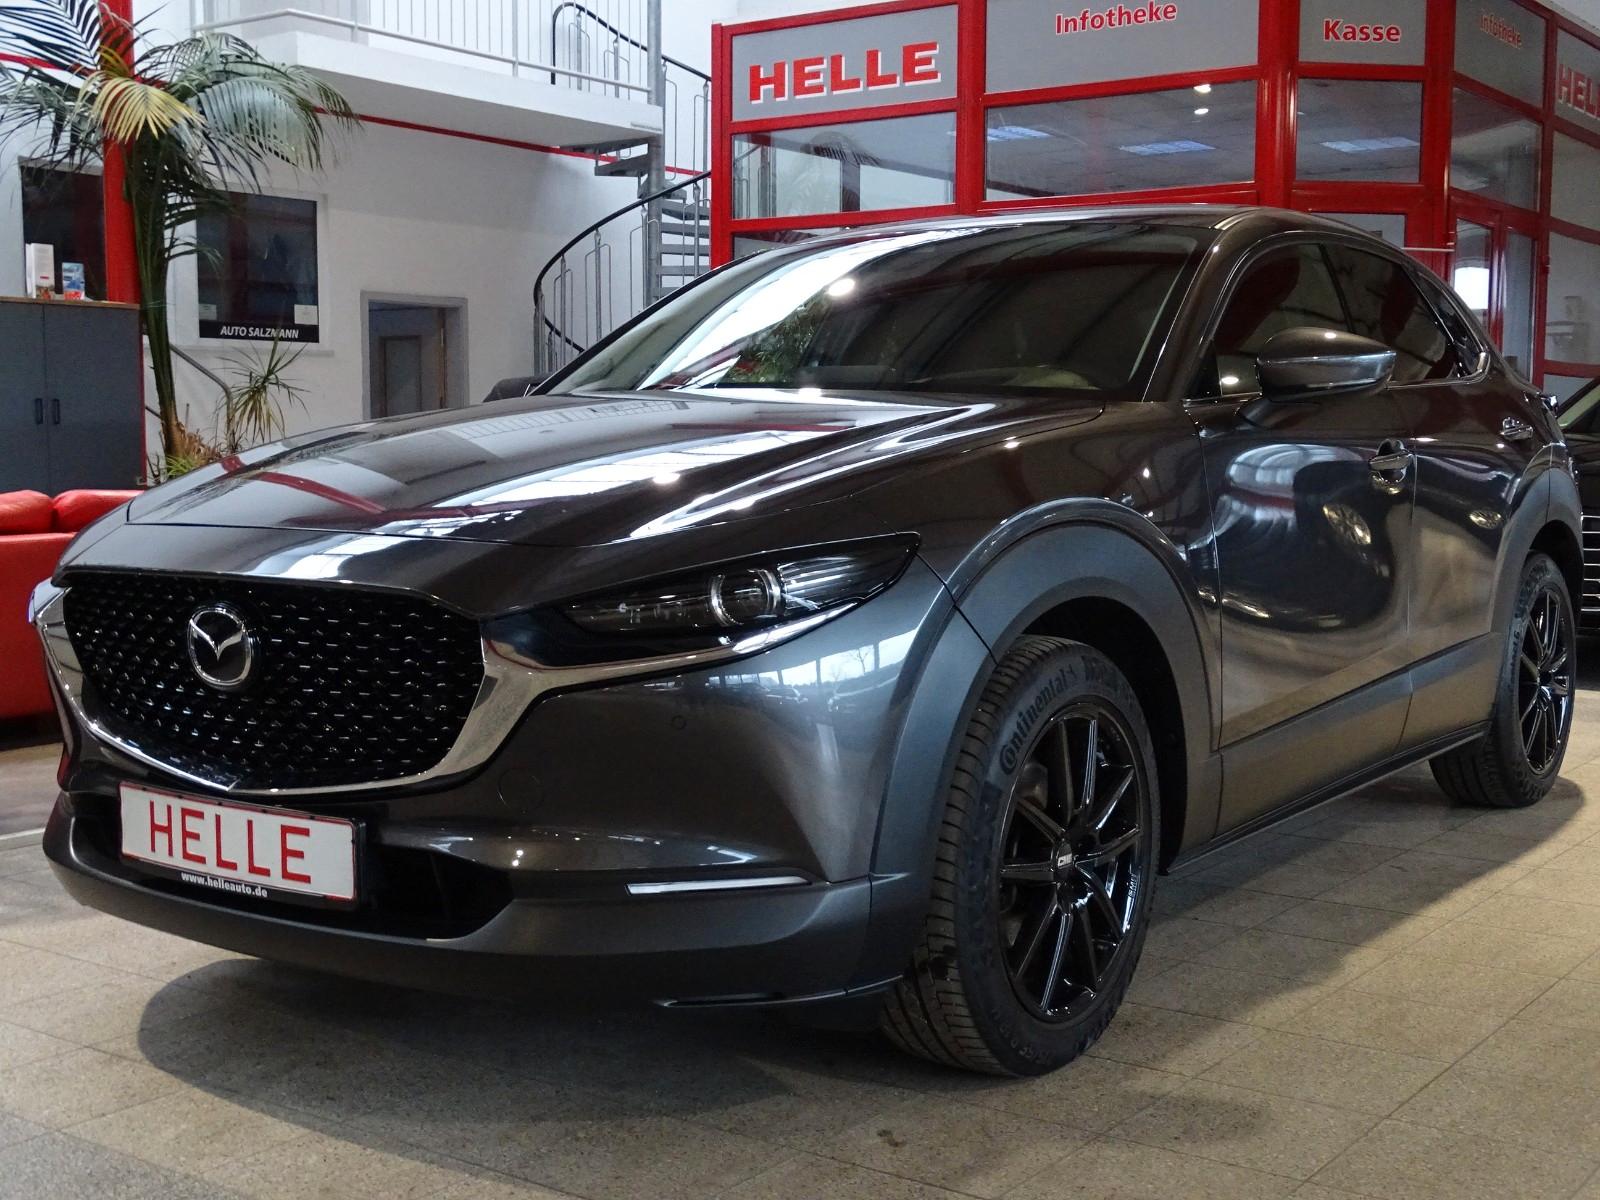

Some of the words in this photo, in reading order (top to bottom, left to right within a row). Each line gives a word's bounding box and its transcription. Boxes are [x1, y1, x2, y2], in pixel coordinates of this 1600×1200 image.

[1056, 0, 1177, 34] Infotheke
[1323, 18, 1401, 43] Kasse
[749, 41, 941, 104] HELLE
[1558, 64, 1600, 120] HEL
[220, 325, 247, 337] AUTO
[1000, 668, 1067, 775] Continental
[150, 800, 312, 884] HELLE
[181, 871, 268, 898] www.helleauto.de
